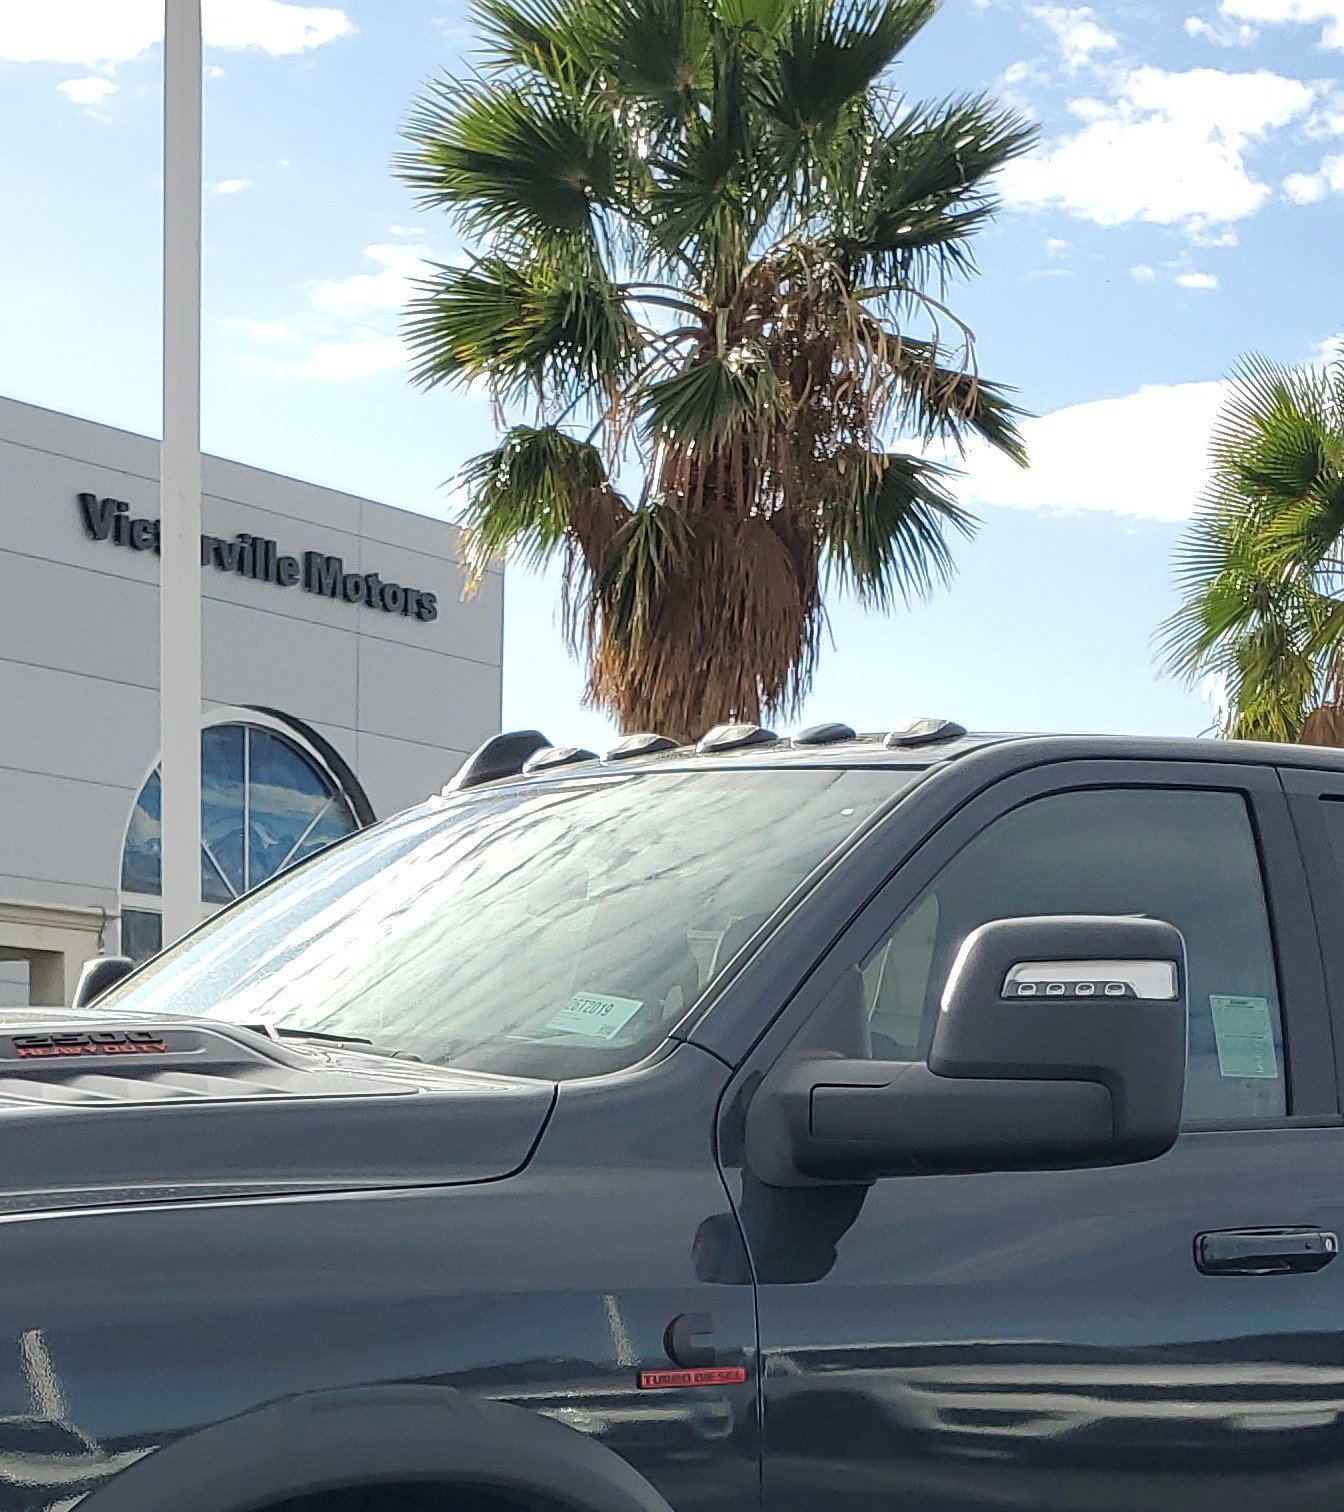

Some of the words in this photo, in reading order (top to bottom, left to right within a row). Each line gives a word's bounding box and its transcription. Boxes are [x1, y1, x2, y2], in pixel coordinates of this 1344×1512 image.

[76, 492, 301, 587] Vicrville
[304, 551, 438, 622] Motors
[12, 1031, 164, 1048] 2500
[16, 1045, 98, 1058] HEAVY
[103, 1042, 168, 1055] DUTY
[644, 1372, 691, 1387] TURBO
[694, 1369, 742, 1384] DIESEL
